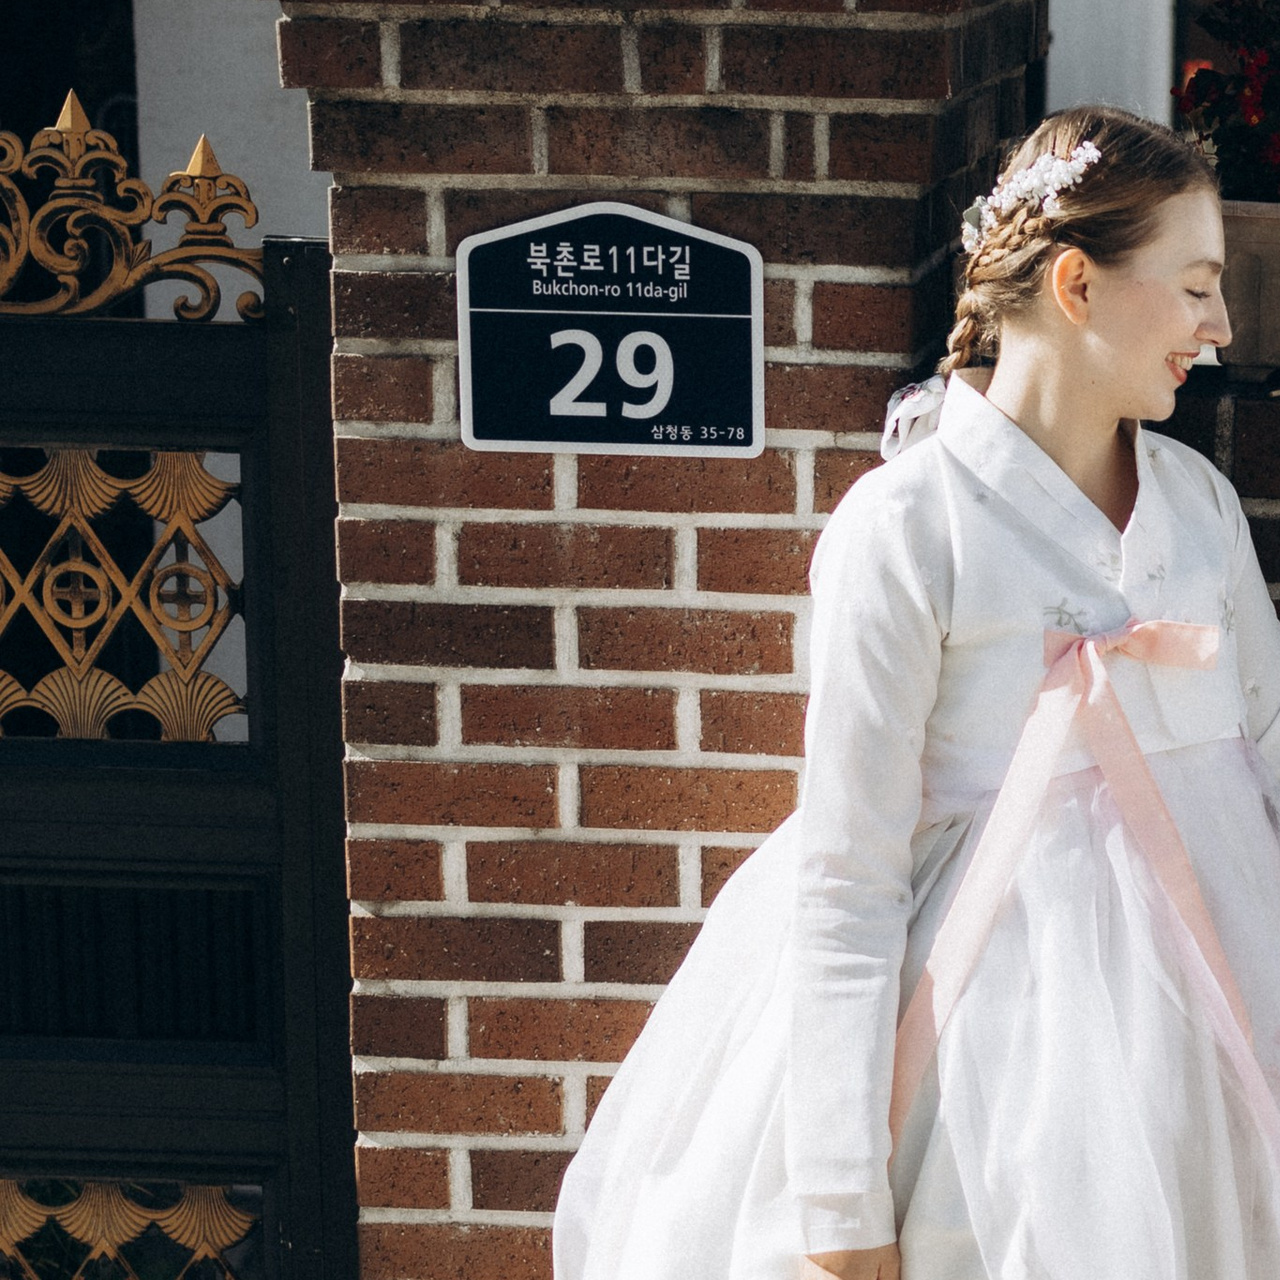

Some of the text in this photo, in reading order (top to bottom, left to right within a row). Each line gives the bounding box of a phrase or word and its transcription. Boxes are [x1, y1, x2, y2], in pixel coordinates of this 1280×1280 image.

[527, 242, 691, 280] 북촌로11다길
[532, 280, 688, 302] Bukchon-ro 11da-gil
[549, 328, 675, 420] 29
[651, 425, 745, 441] 삼청동 35-78
